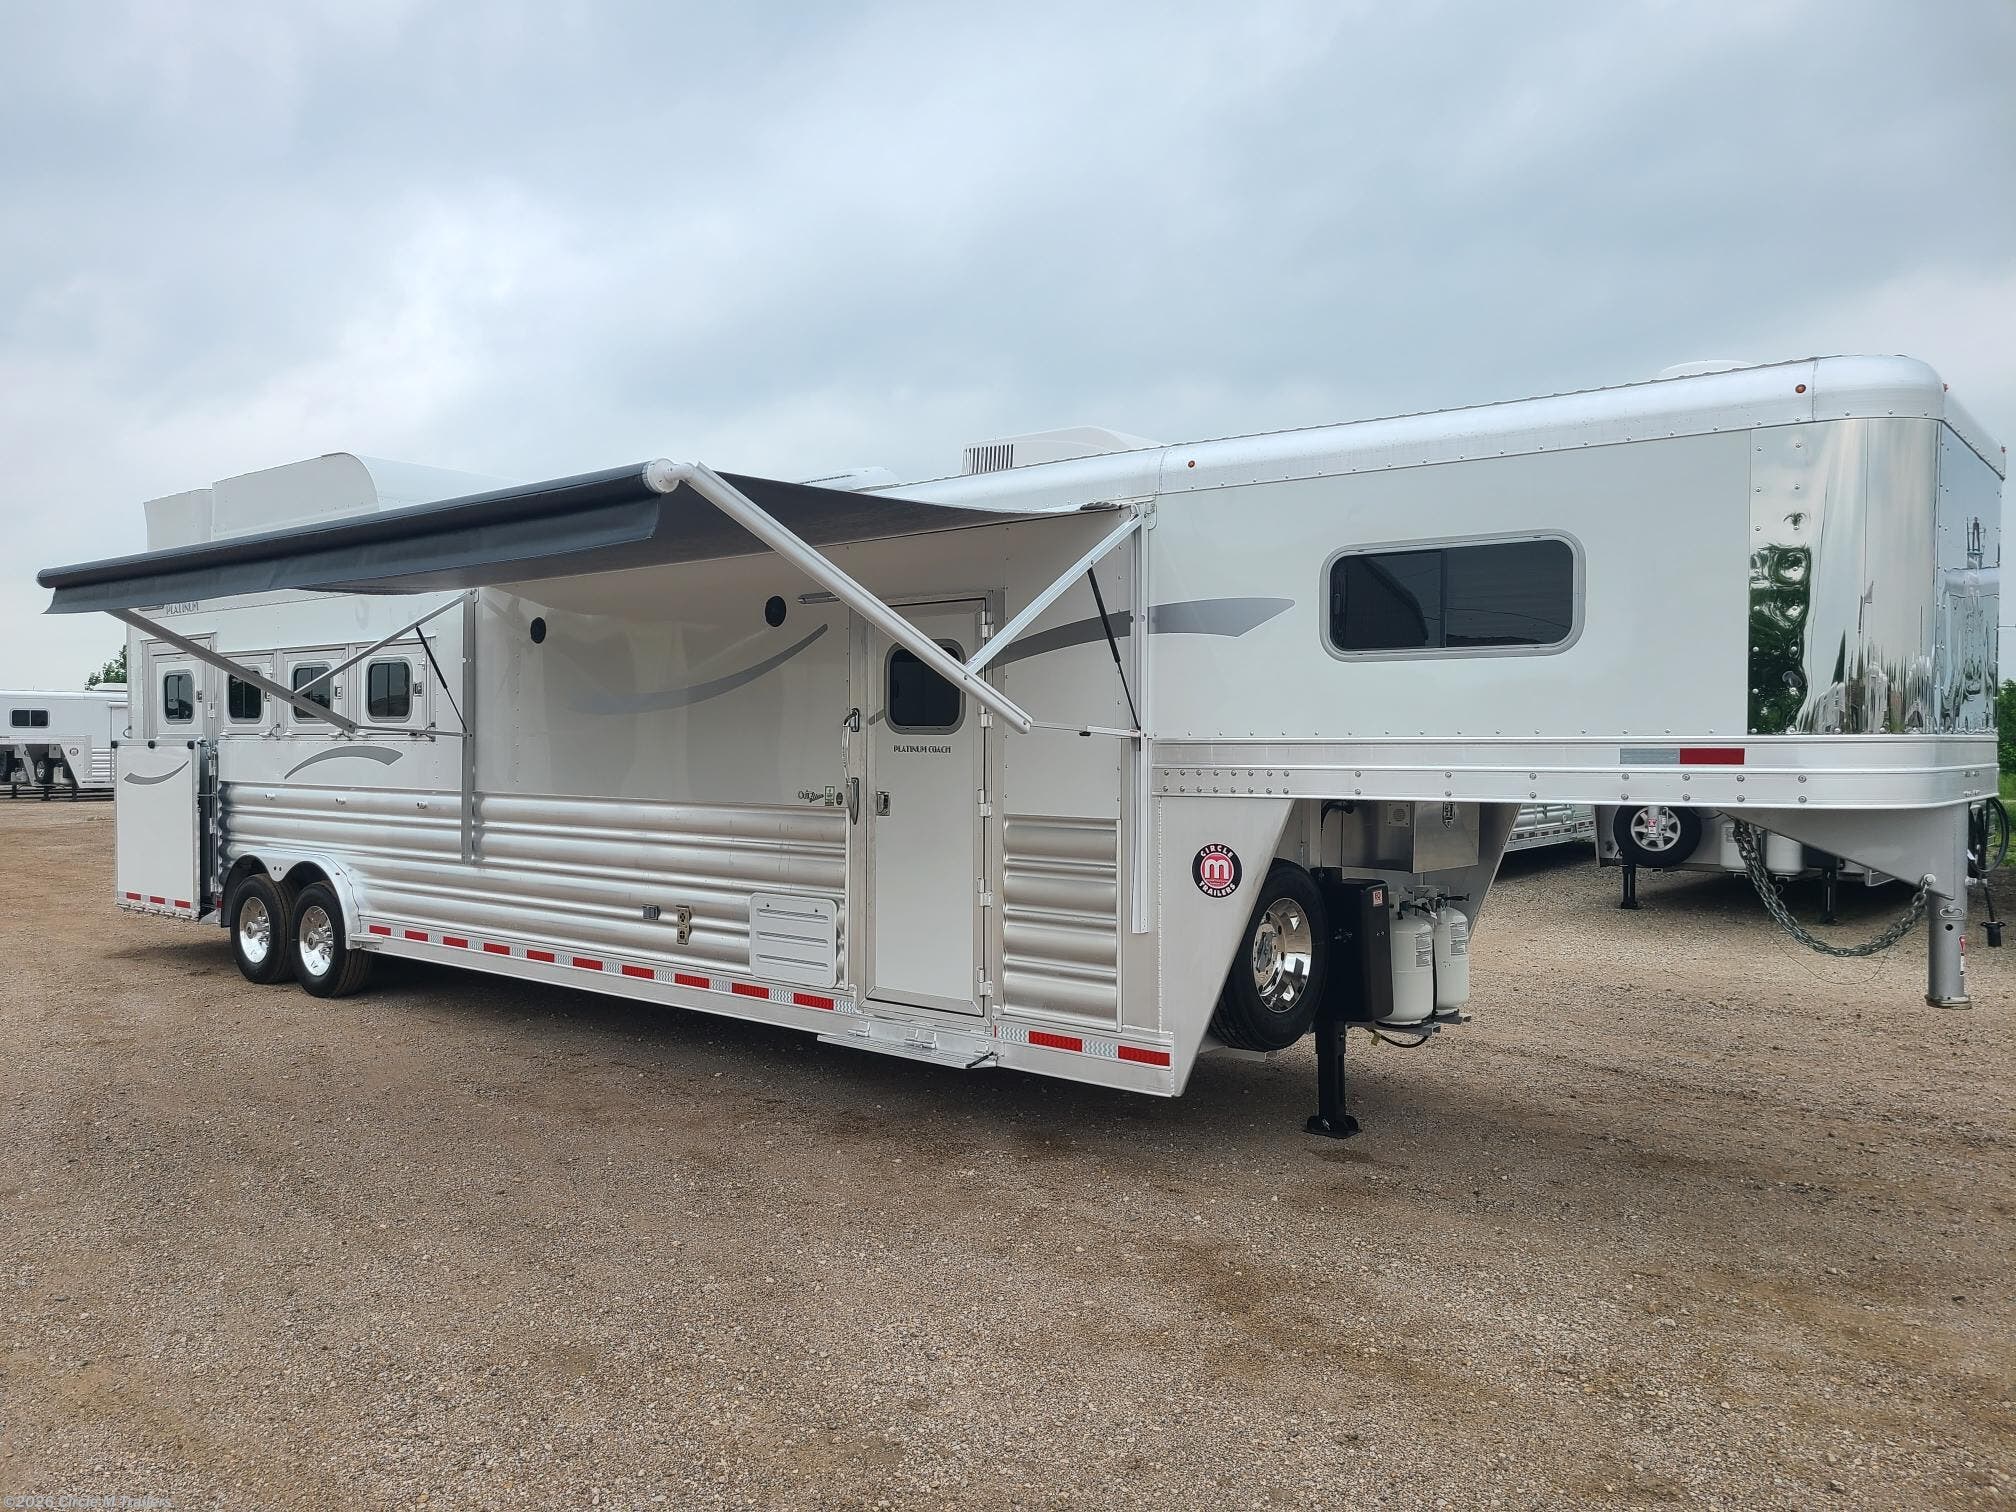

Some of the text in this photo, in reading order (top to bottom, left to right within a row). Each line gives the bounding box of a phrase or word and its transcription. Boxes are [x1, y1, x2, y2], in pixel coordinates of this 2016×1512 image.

[165, 601, 199, 616] PLATINUM
[893, 744, 952, 754] PLATINUM COACH
[1200, 845, 1234, 858] CIRCLE
[1199, 880, 1236, 897] TRAILERS
